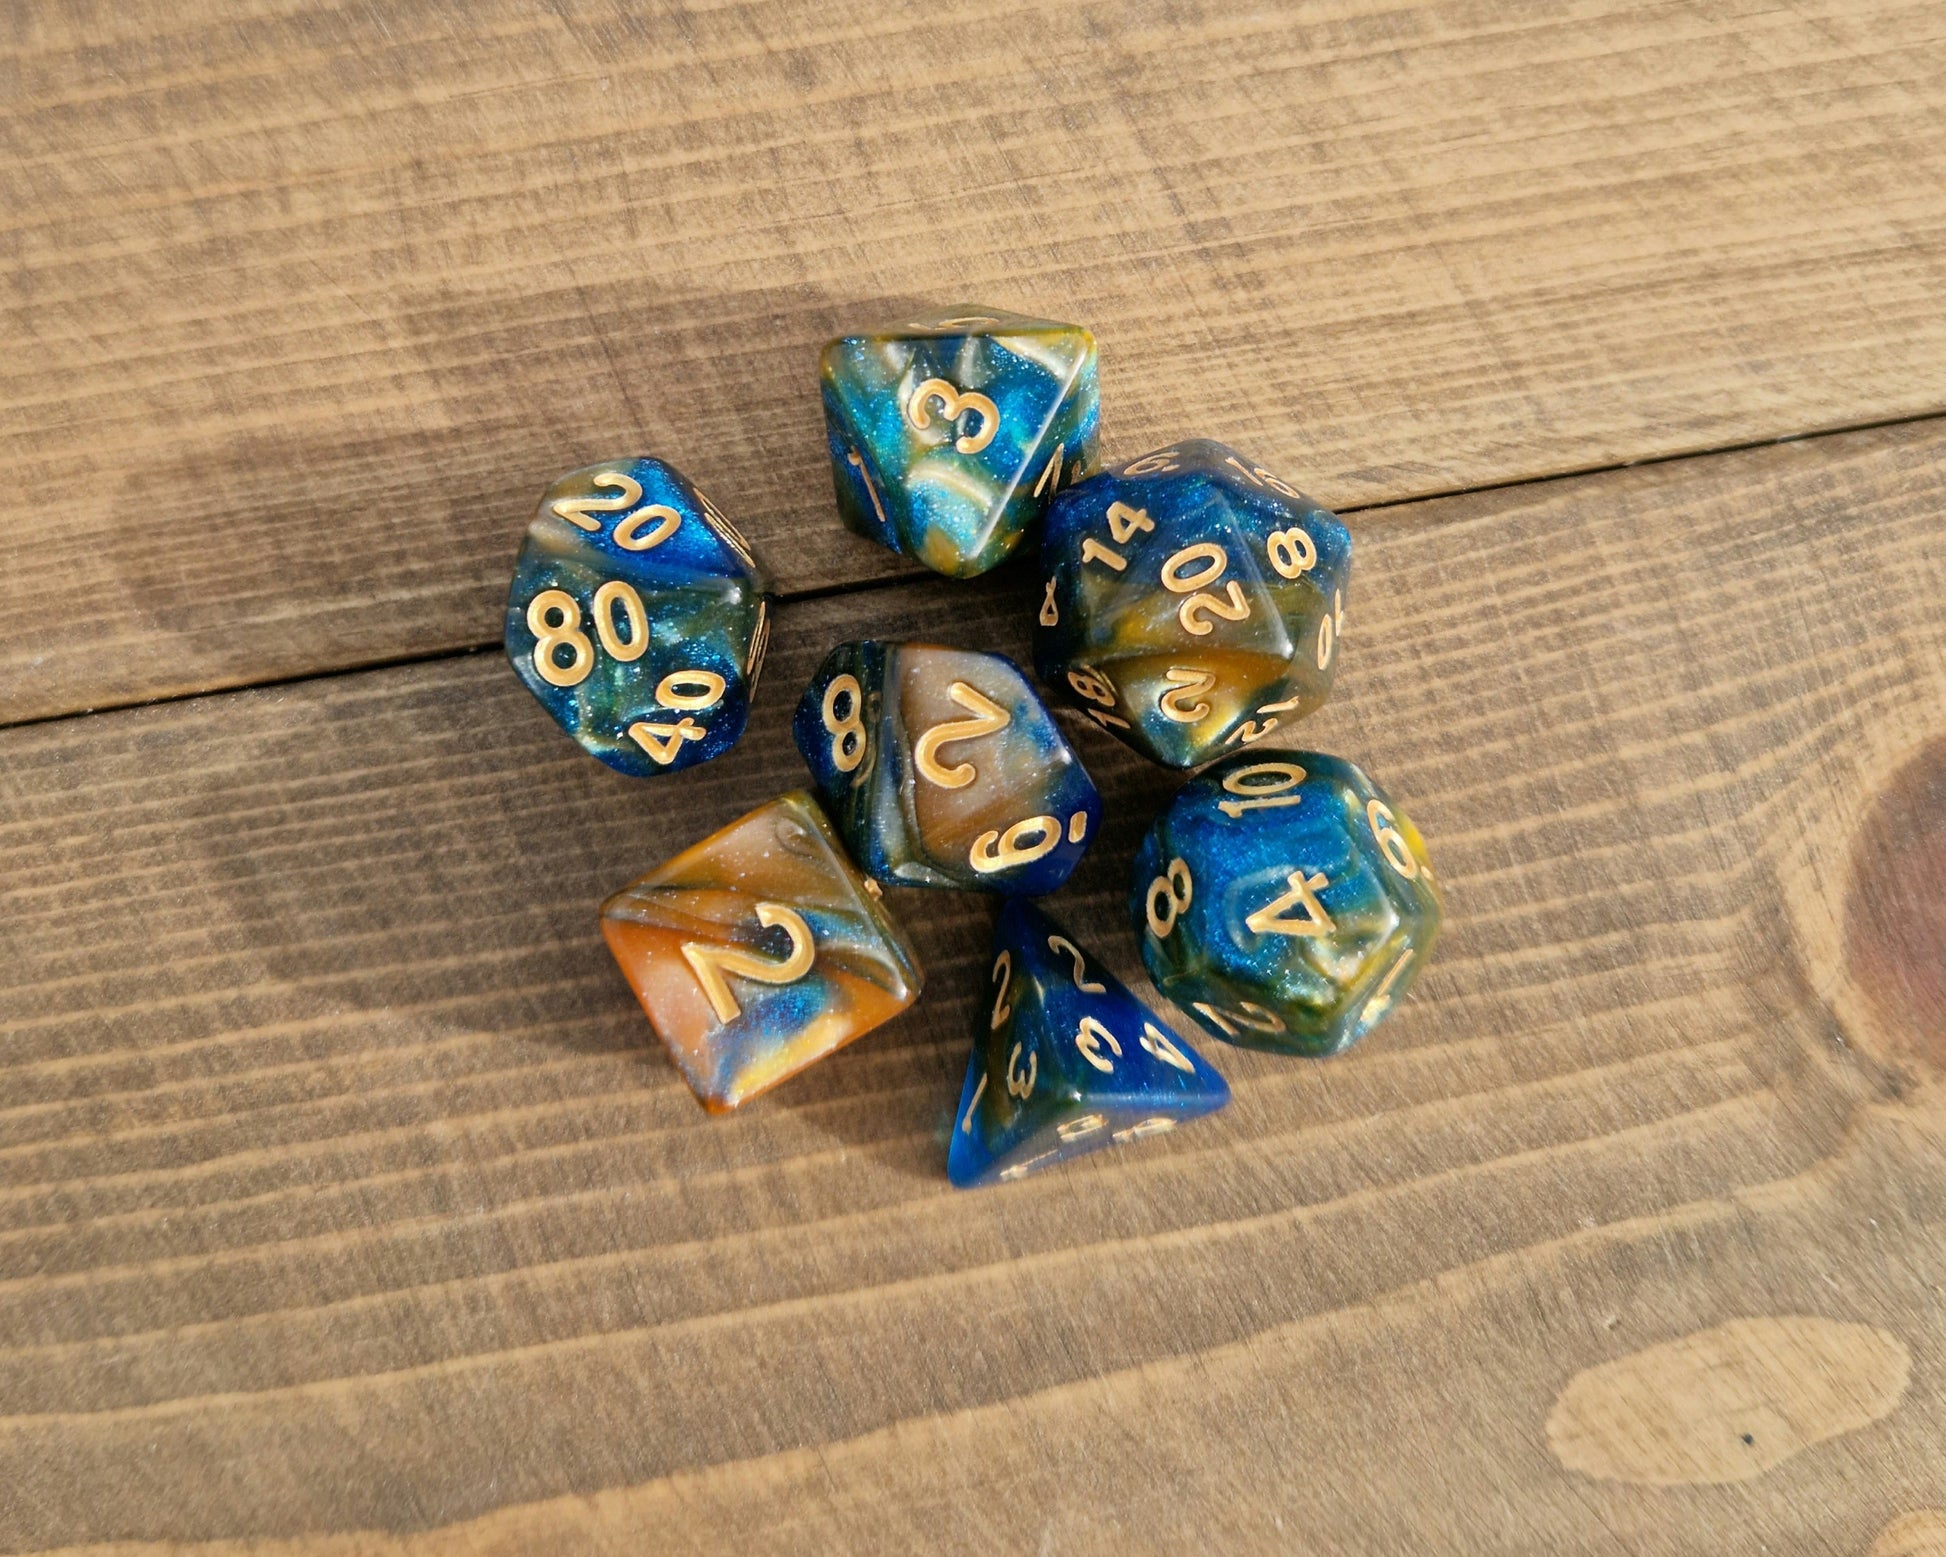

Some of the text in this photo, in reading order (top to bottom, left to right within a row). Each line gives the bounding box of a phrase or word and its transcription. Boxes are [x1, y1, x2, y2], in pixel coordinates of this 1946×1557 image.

[909, 378, 1000, 454] 3
[1225, 456, 1300, 499] 16
[553, 473, 681, 551] 20
[1082, 501, 1155, 571] 14
[1267, 527, 1317, 579] 8
[1161, 543, 1250, 635] 20
[527, 580, 649, 687] 80
[628, 670, 726, 765] 40
[822, 674, 866, 772] 8
[1067, 671, 1130, 729] 18
[1160, 667, 1216, 723] 2
[1225, 695, 1299, 745] 12
[915, 682, 1011, 789] 2
[1218, 762, 1306, 818] 10
[1146, 858, 1192, 938] 8
[1246, 870, 1336, 937] 4
[680, 903, 815, 1024] 2
[991, 949, 1012, 1030] 2
[1048, 936, 1106, 993] 2
[1007, 1041, 1037, 1100] 3
[1075, 1016, 1122, 1074] 3
[1140, 1022, 1195, 1074] 4
[962, 1073, 987, 1134] 1
